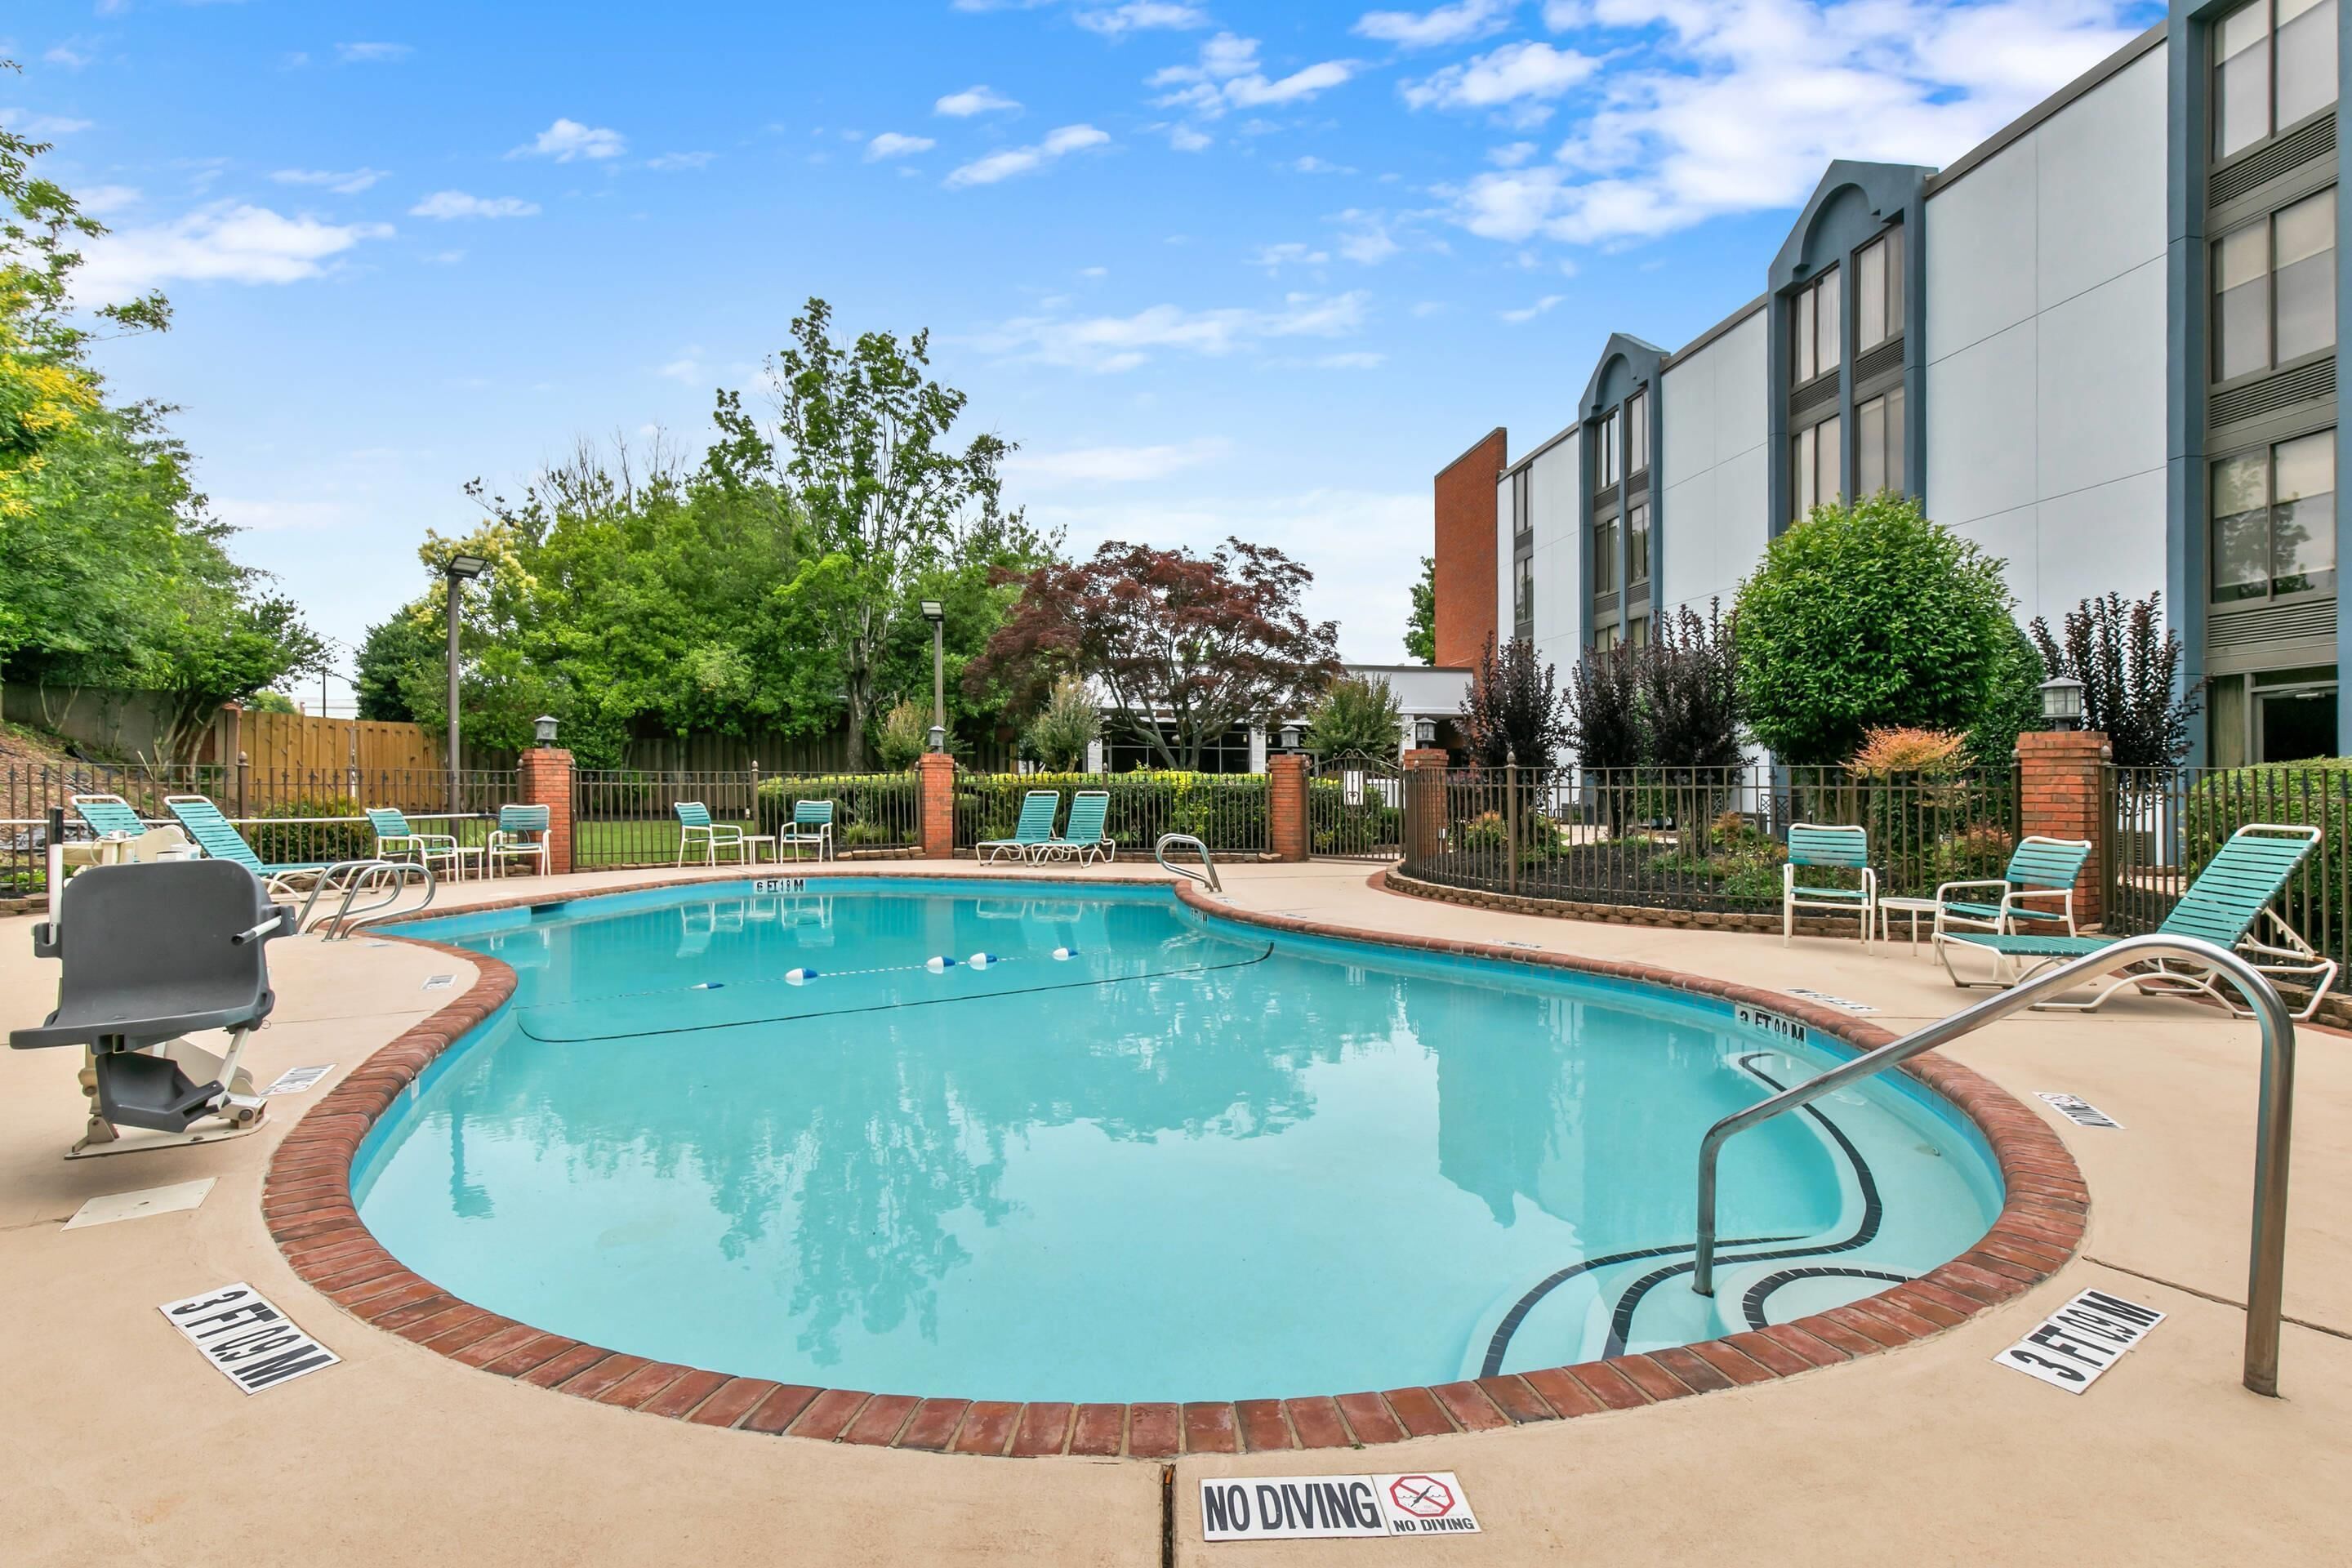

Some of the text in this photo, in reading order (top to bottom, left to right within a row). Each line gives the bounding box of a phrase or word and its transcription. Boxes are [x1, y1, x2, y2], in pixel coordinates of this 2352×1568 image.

[1204, 1481, 1383, 1532] NO DIVING
[1392, 1517, 1475, 1533] NO DIVING
